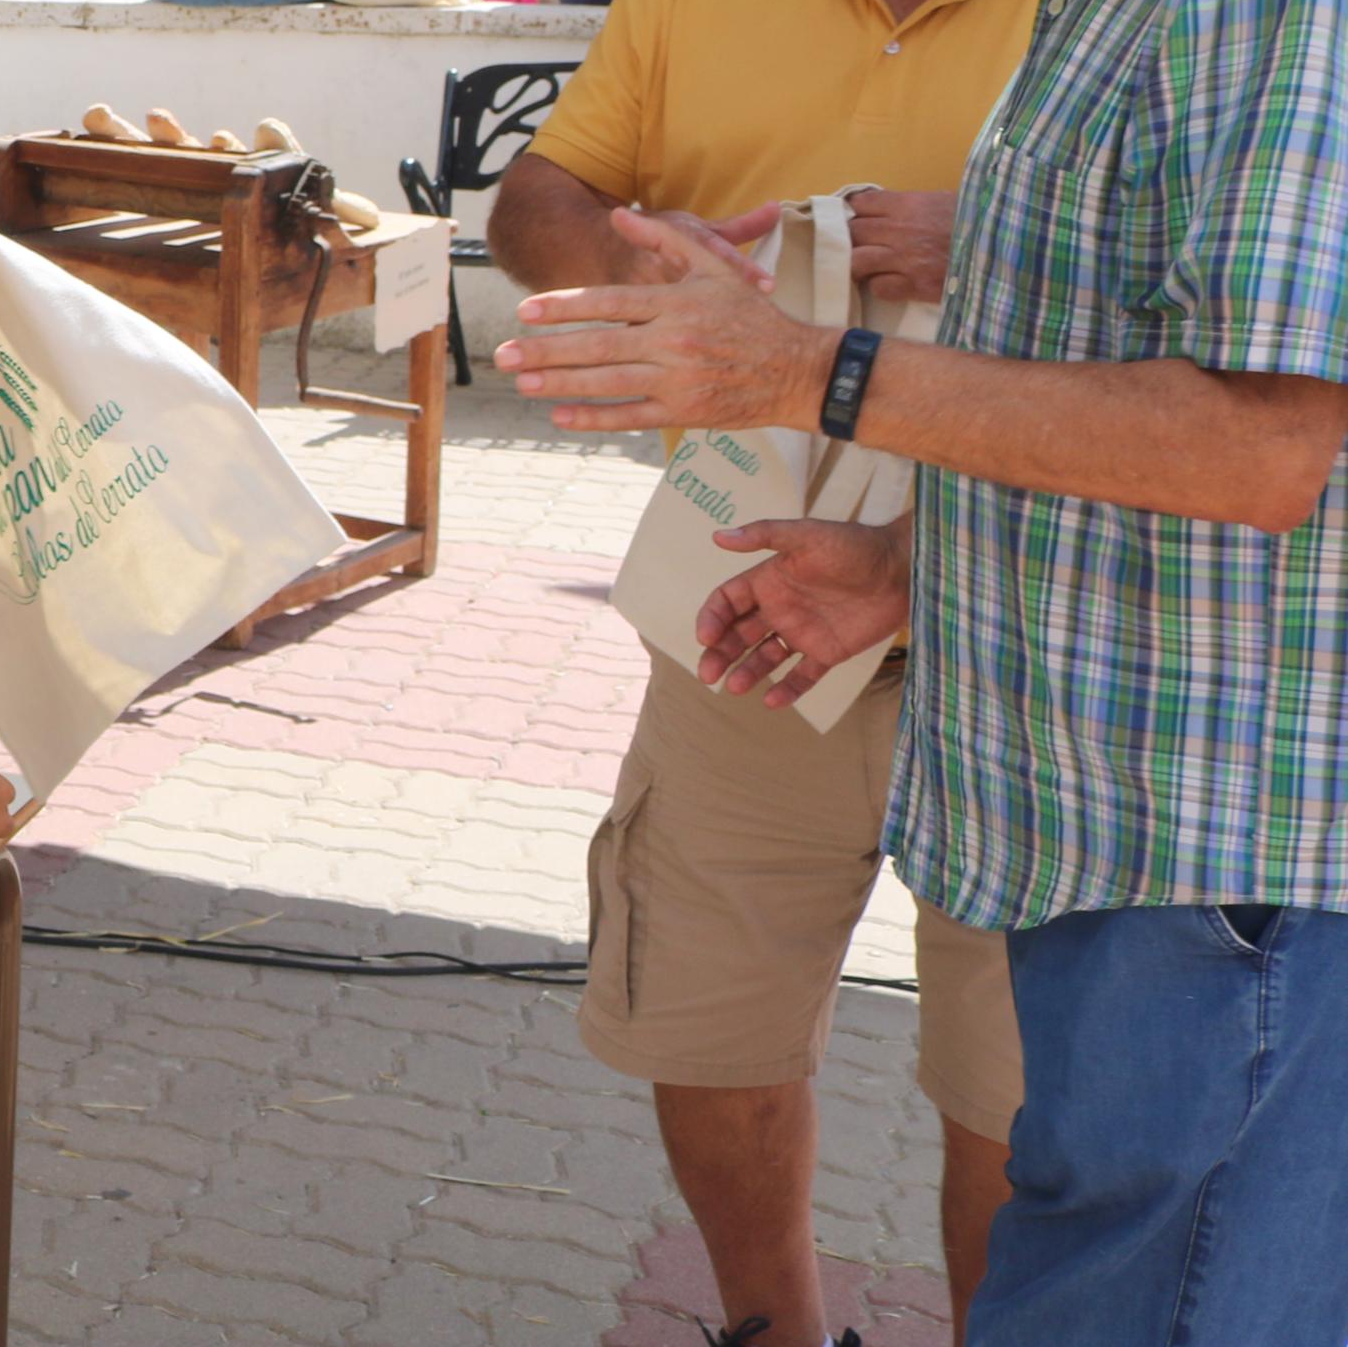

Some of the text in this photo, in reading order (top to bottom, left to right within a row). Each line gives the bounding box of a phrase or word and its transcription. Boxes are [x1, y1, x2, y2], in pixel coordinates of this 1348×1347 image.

[53, 398, 124, 460] Cerrato
[75, 443, 169, 525] Cerrato
[666, 437, 737, 526] Cerrato
